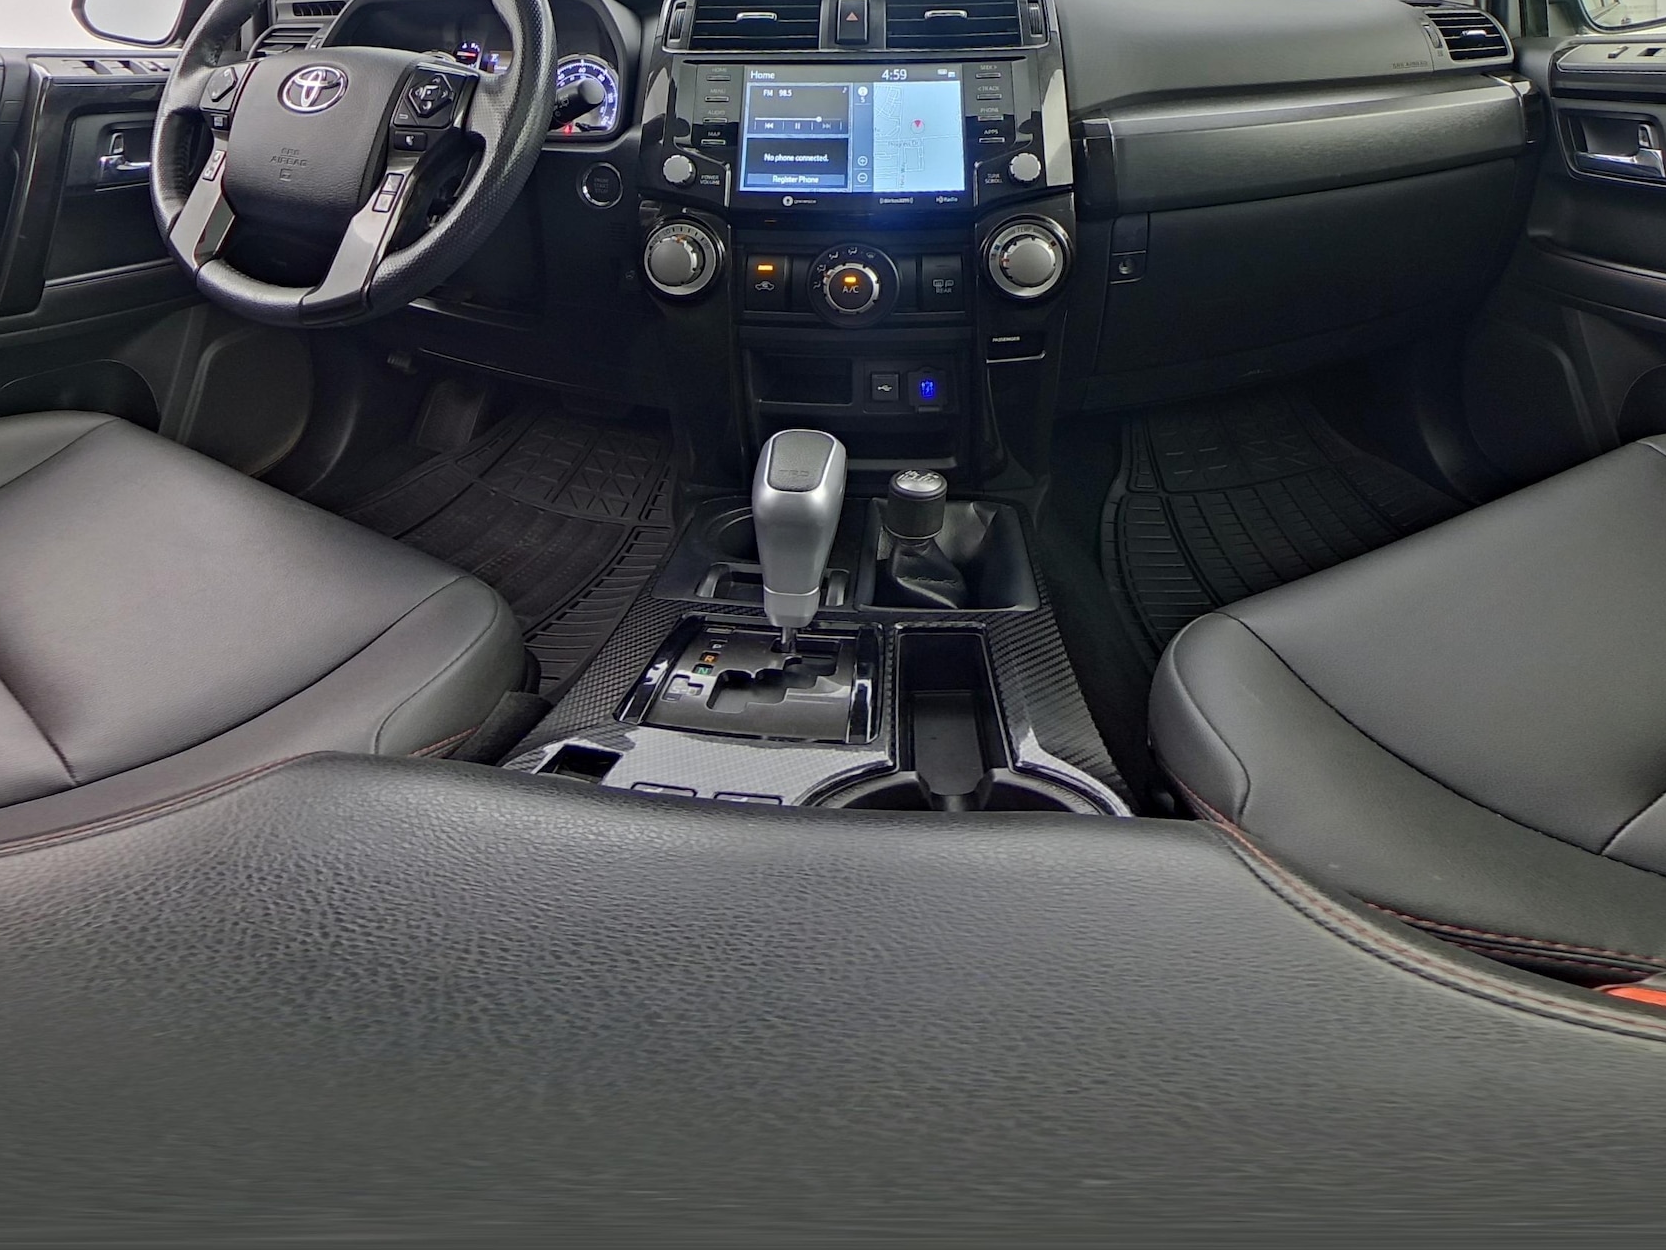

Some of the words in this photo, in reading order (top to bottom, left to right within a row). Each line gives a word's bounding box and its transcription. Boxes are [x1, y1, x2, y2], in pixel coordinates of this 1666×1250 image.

[750, 70, 775, 80] Home
[881, 68, 908, 81] 4:59
[763, 89, 774, 97] FM
[778, 89, 793, 97] 98.5
[763, 153, 774, 162] No
[774, 153, 794, 163] phone
[795, 153, 829, 162] connected.
[772, 175, 798, 184] Register
[798, 175, 819, 183] Phone
[841, 285, 860, 294] A/C
